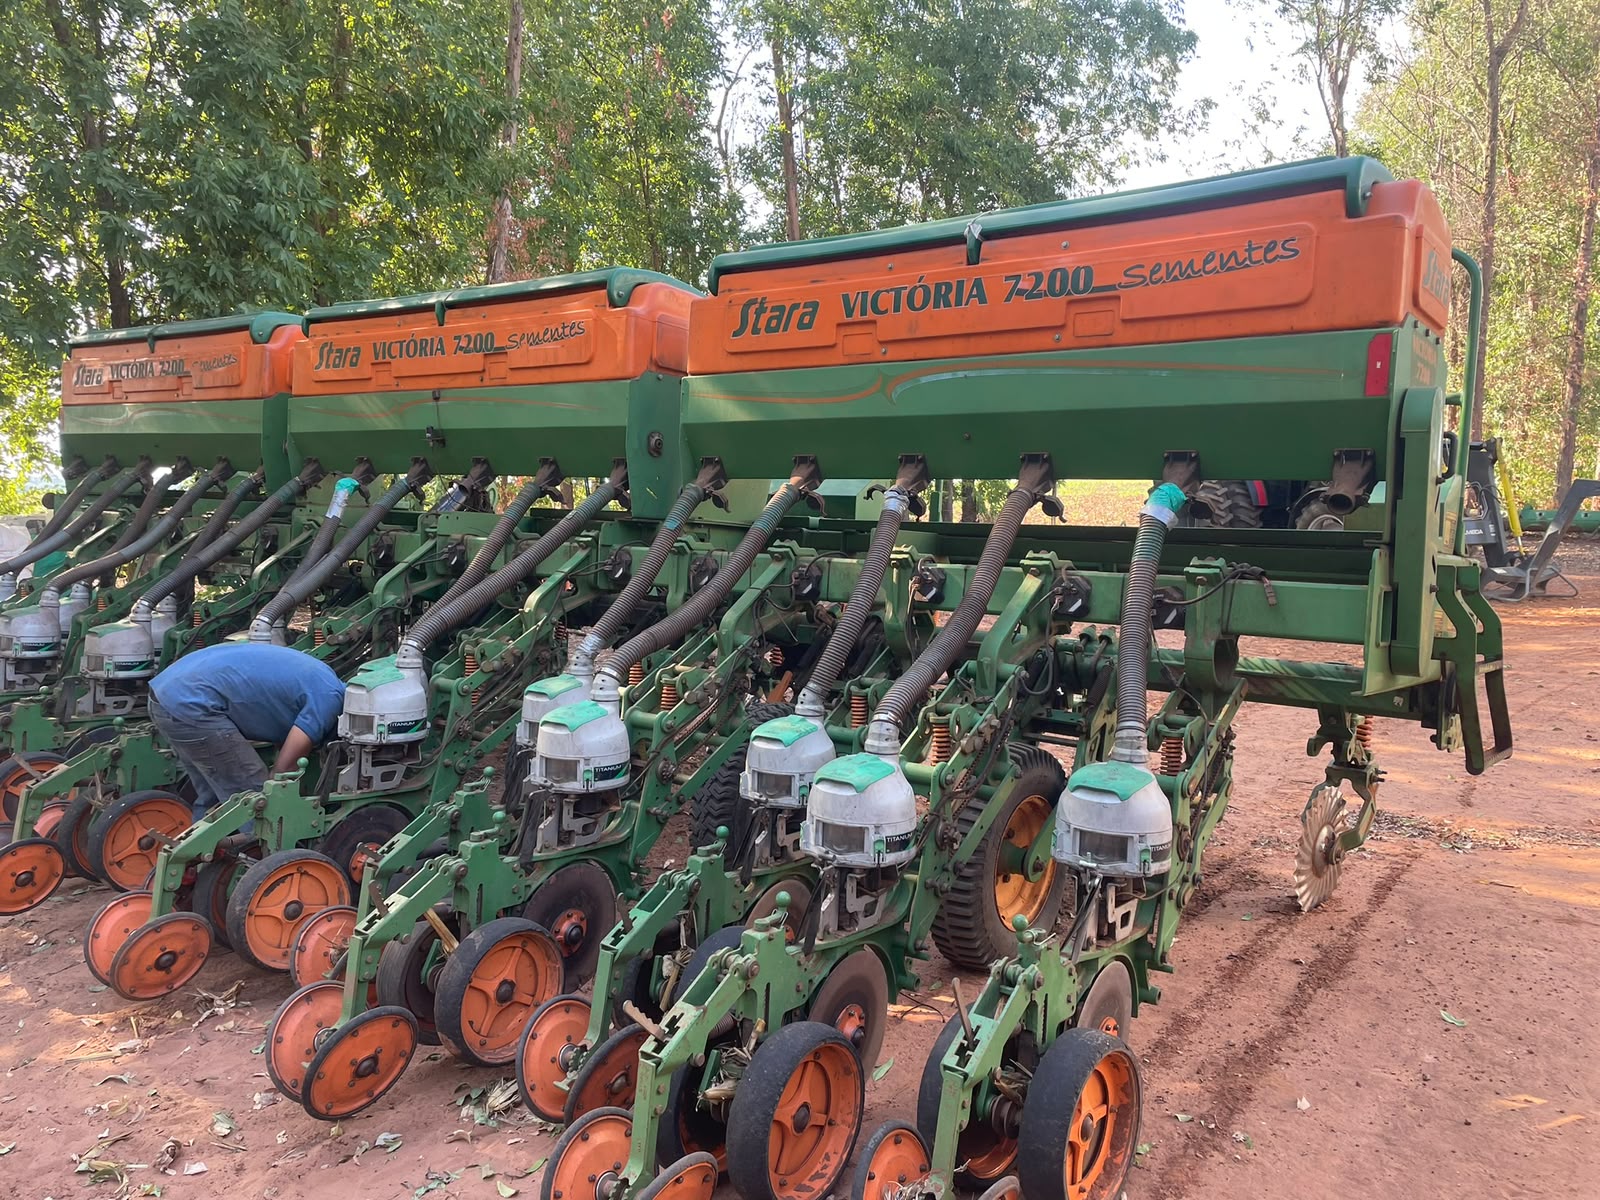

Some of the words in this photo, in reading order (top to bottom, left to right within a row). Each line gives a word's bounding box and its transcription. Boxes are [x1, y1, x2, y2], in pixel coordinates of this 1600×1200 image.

[730, 296, 820, 340] Stara
[840, 275, 988, 320] VICTÓRIA
[1002, 265, 1095, 304] 7200
[1116, 236, 1301, 290] Sementes
[1422, 250, 1450, 305] Stara
[314, 341, 362, 371] Stara
[372, 333, 447, 361] VICTÓRIA
[453, 331, 496, 355] 7200
[505, 320, 587, 350] Sementes
[74, 363, 104, 387] Stara
[109, 358, 155, 380] VICTÓRIA
[594, 764, 622, 773] TITANIUM
[886, 832, 914, 843] TITANIUM
